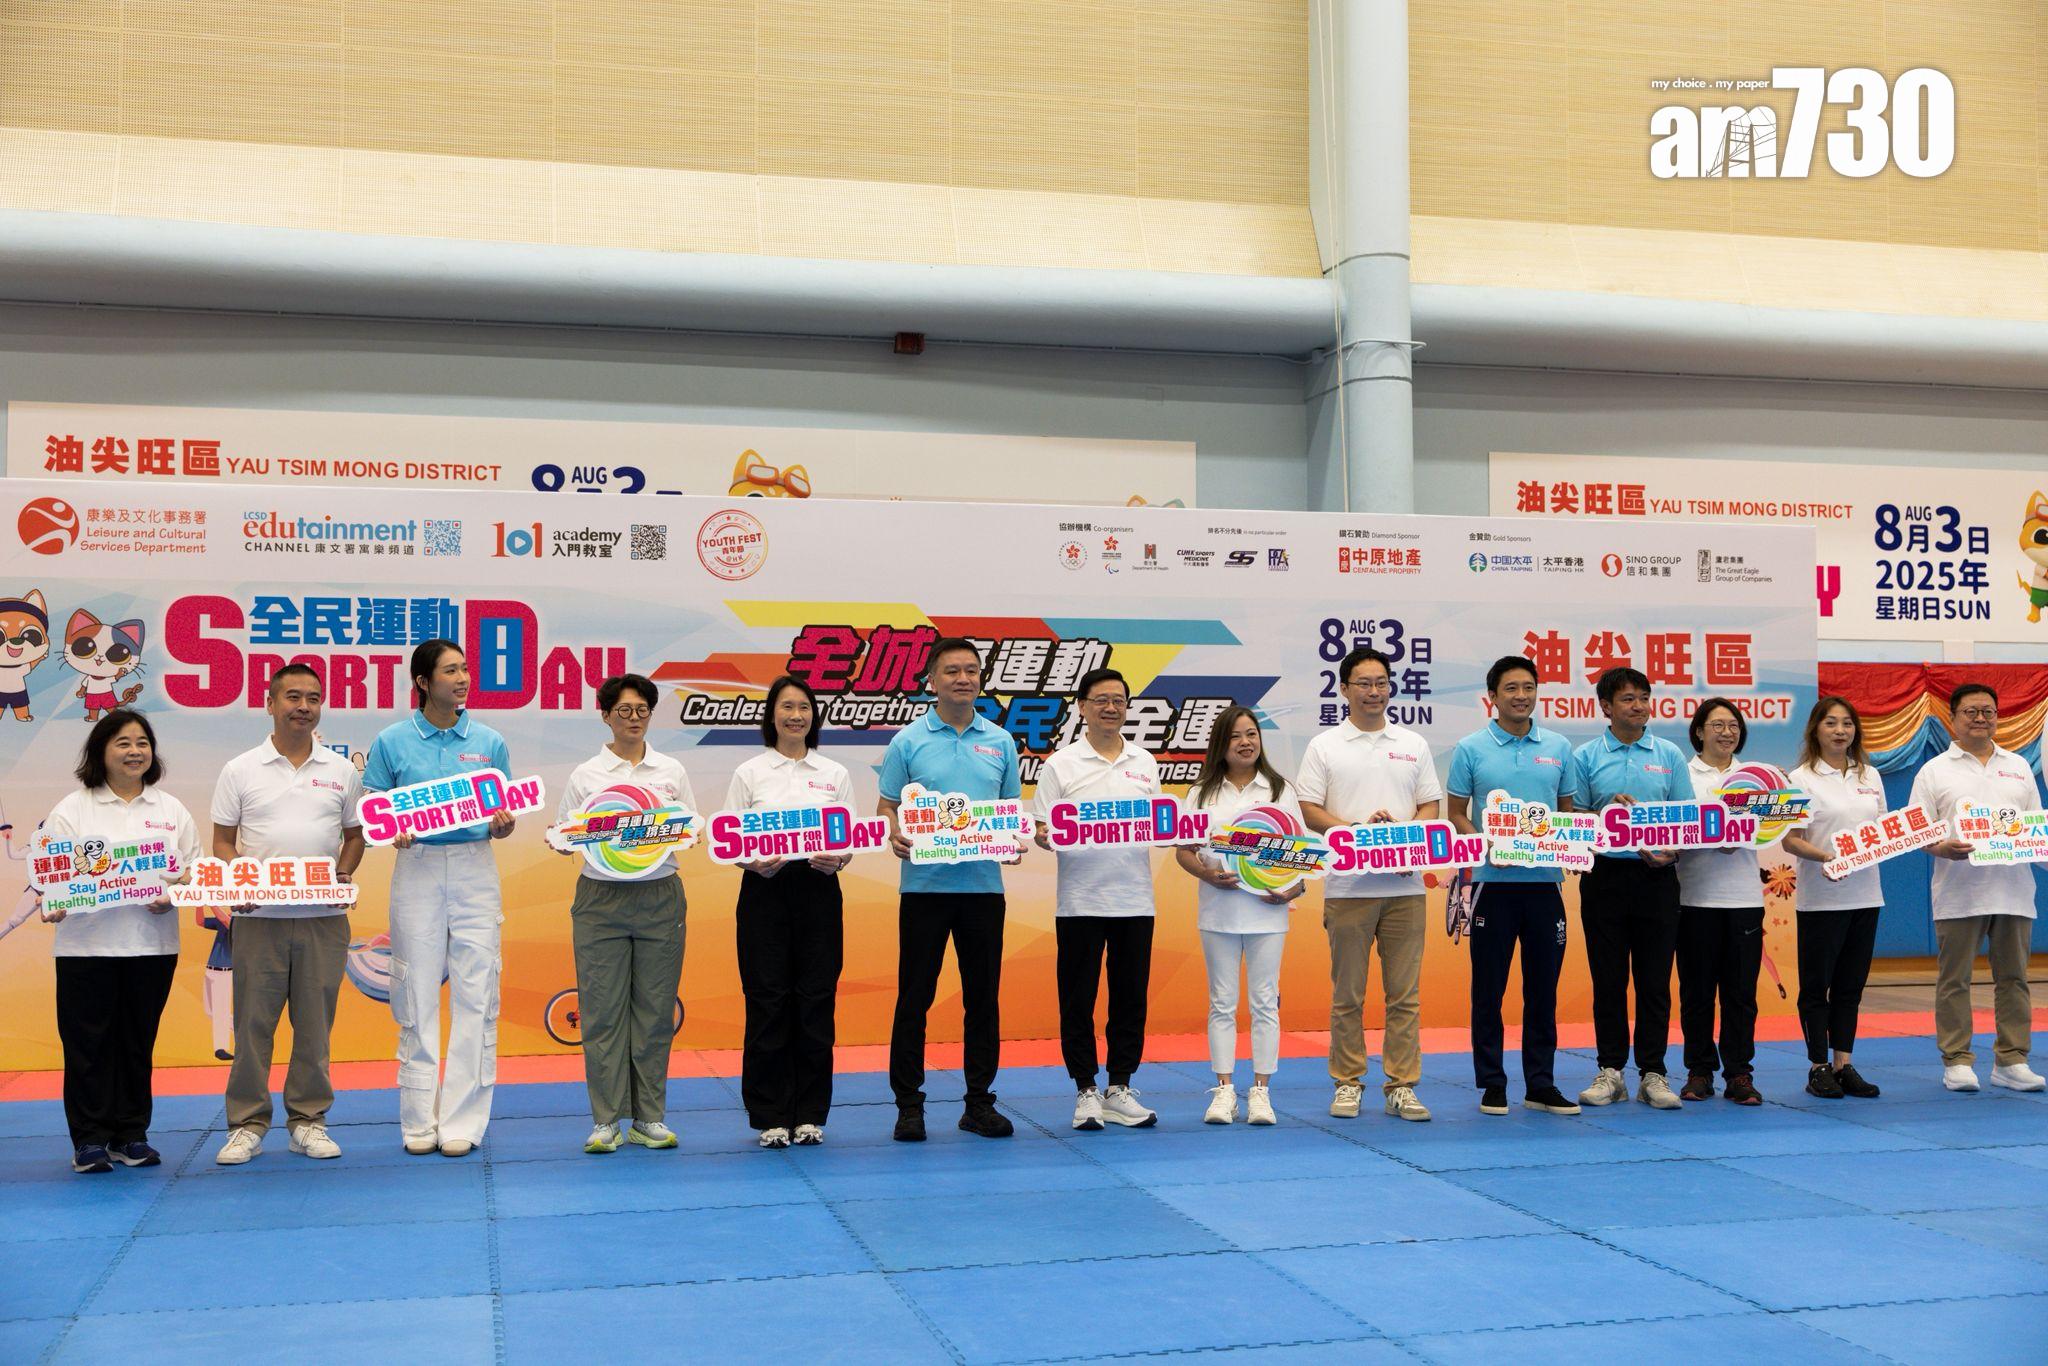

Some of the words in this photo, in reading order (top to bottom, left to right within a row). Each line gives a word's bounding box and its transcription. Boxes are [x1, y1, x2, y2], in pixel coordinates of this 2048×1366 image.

[43, 435, 221, 476] 油尖旺區
[226, 457, 270, 475] YAU
[277, 459, 327, 477] TSIM
[333, 461, 399, 479] MONG
[405, 463, 501, 481] DISTRICT
[572, 466, 607, 484] AUG
[1517, 481, 1646, 516] 油尖旺區
[86, 508, 207, 525] 康樂及文化事務署
[244, 511, 268, 521] LCSD
[1650, 499, 1682, 514] YAU
[1687, 500, 1724, 516] TSIM
[1729, 502, 1777, 517] MONG
[1782, 503, 1853, 519] DISTRICT
[1905, 506, 1932, 521] AUG
[87, 527, 129, 539] Leisure
[133, 528, 155, 539] and
[159, 528, 206, 540] Cultural
[243, 512, 416, 541] edutainment
[1093, 525, 1133, 533] Co-organisers
[552, 527, 622, 545] academy
[703, 536, 736, 548] YOUTH
[738, 532, 761, 544] FEST
[80, 541, 130, 552] Services
[134, 541, 207, 556] Department
[244, 542, 310, 552] CHANNEL
[552, 544, 613, 558] 入門教室
[1352, 548, 1421, 566] 中原地產
[1491, 555, 1532, 565] 中国太平
[1543, 556, 1584, 566] 太平香港
[1626, 556, 1648, 564] SINO
[1650, 556, 1682, 565] GROUP
[1626, 566, 1672, 577] 信和集團
[1715, 575, 1734, 583] Group
[1876, 559, 1990, 595] 2025年
[249, 596, 459, 646] 全民運動
[1349, 619, 1376, 634] AUG
[465, 600, 626, 709] DAY
[788, 627, 1108, 692] 全城運動
[1522, 630, 1752, 685] 油尖旺區
[831, 697, 927, 726] togethe
[1540, 697, 1595, 719] TSIM
[392, 778, 473, 812] 全民運動
[471, 773, 540, 818] DAY
[916, 797, 937, 807] 日日
[457, 799, 477, 812] FOR
[973, 805, 1017, 816] 健康快樂
[1080, 799, 1150, 821] 全民運動
[1500, 803, 1519, 812] 日日
[362, 797, 455, 841] SPORT
[459, 809, 480, 822] ALL
[743, 808, 821, 833] 全民運動
[904, 809, 935, 824] 運動
[1152, 799, 1208, 840] DAY
[1488, 813, 1516, 827] 運動
[1552, 817, 1594, 828] 健康快樂
[1631, 805, 1699, 825] 全民運動
[822, 806, 885, 850] DAY
[978, 816, 1020, 831] 人輕鬆
[1051, 804, 1132, 845] SPORT
[1134, 821, 1151, 831] FOR
[1605, 808, 1680, 847] SPORT
[1683, 825, 1699, 834] FOR
[1700, 804, 1755, 843] DAY
[712, 815, 800, 859] SPORT
[803, 830, 822, 841] FOR
[934, 836, 957, 846] Stay
[960, 833, 992, 844] Active
[1134, 831, 1152, 842] ALL
[1356, 825, 1425, 847] 全民運動
[1556, 829, 1594, 841] 人輕鬆
[1683, 833, 1699, 844] ALL
[1836, 807, 1928, 857] 油尖旺區
[48, 841, 72, 855] 日日
[113, 841, 165, 859] 健康快樂
[804, 842, 823, 853] ALL
[916, 848, 957, 859] Healthy
[960, 846, 978, 856] and
[981, 845, 1015, 855] Happy
[1329, 831, 1407, 871] SPORT
[1409, 846, 1426, 855] FOR
[1426, 824, 1483, 864] DAY
[1513, 840, 1535, 852] Stay
[1538, 841, 1568, 851] Active
[1829, 862, 1848, 874] YAU
[1850, 852, 1874, 866] TSIM
[1874, 841, 1903, 859] MONG
[1905, 824, 1947, 847] DISTRICT
[1989, 841, 2012, 850] Stay
[2015, 839, 2045, 847] Active
[1411, 855, 1427, 866] ALL
[1496, 851, 1534, 863] Healthy
[1536, 853, 1554, 861] and
[1557, 854, 1588, 865] Happy
[1974, 850, 2013, 860] Healthy
[2015, 848, 2033, 857] and
[34, 855, 71, 874] 運動
[120, 854, 167, 874] 人輕鬆
[197, 862, 331, 887] 油尖旺區
[69, 883, 97, 895] Stay
[100, 876, 137, 890] Active
[48, 895, 96, 911] Healthy
[98, 890, 121, 903] and
[123, 885, 162, 899] Happy
[174, 890, 201, 901] YAU
[208, 890, 240, 901] TSIM
[244, 889, 287, 900] MONG
[291, 888, 354, 900] DISTRICT
